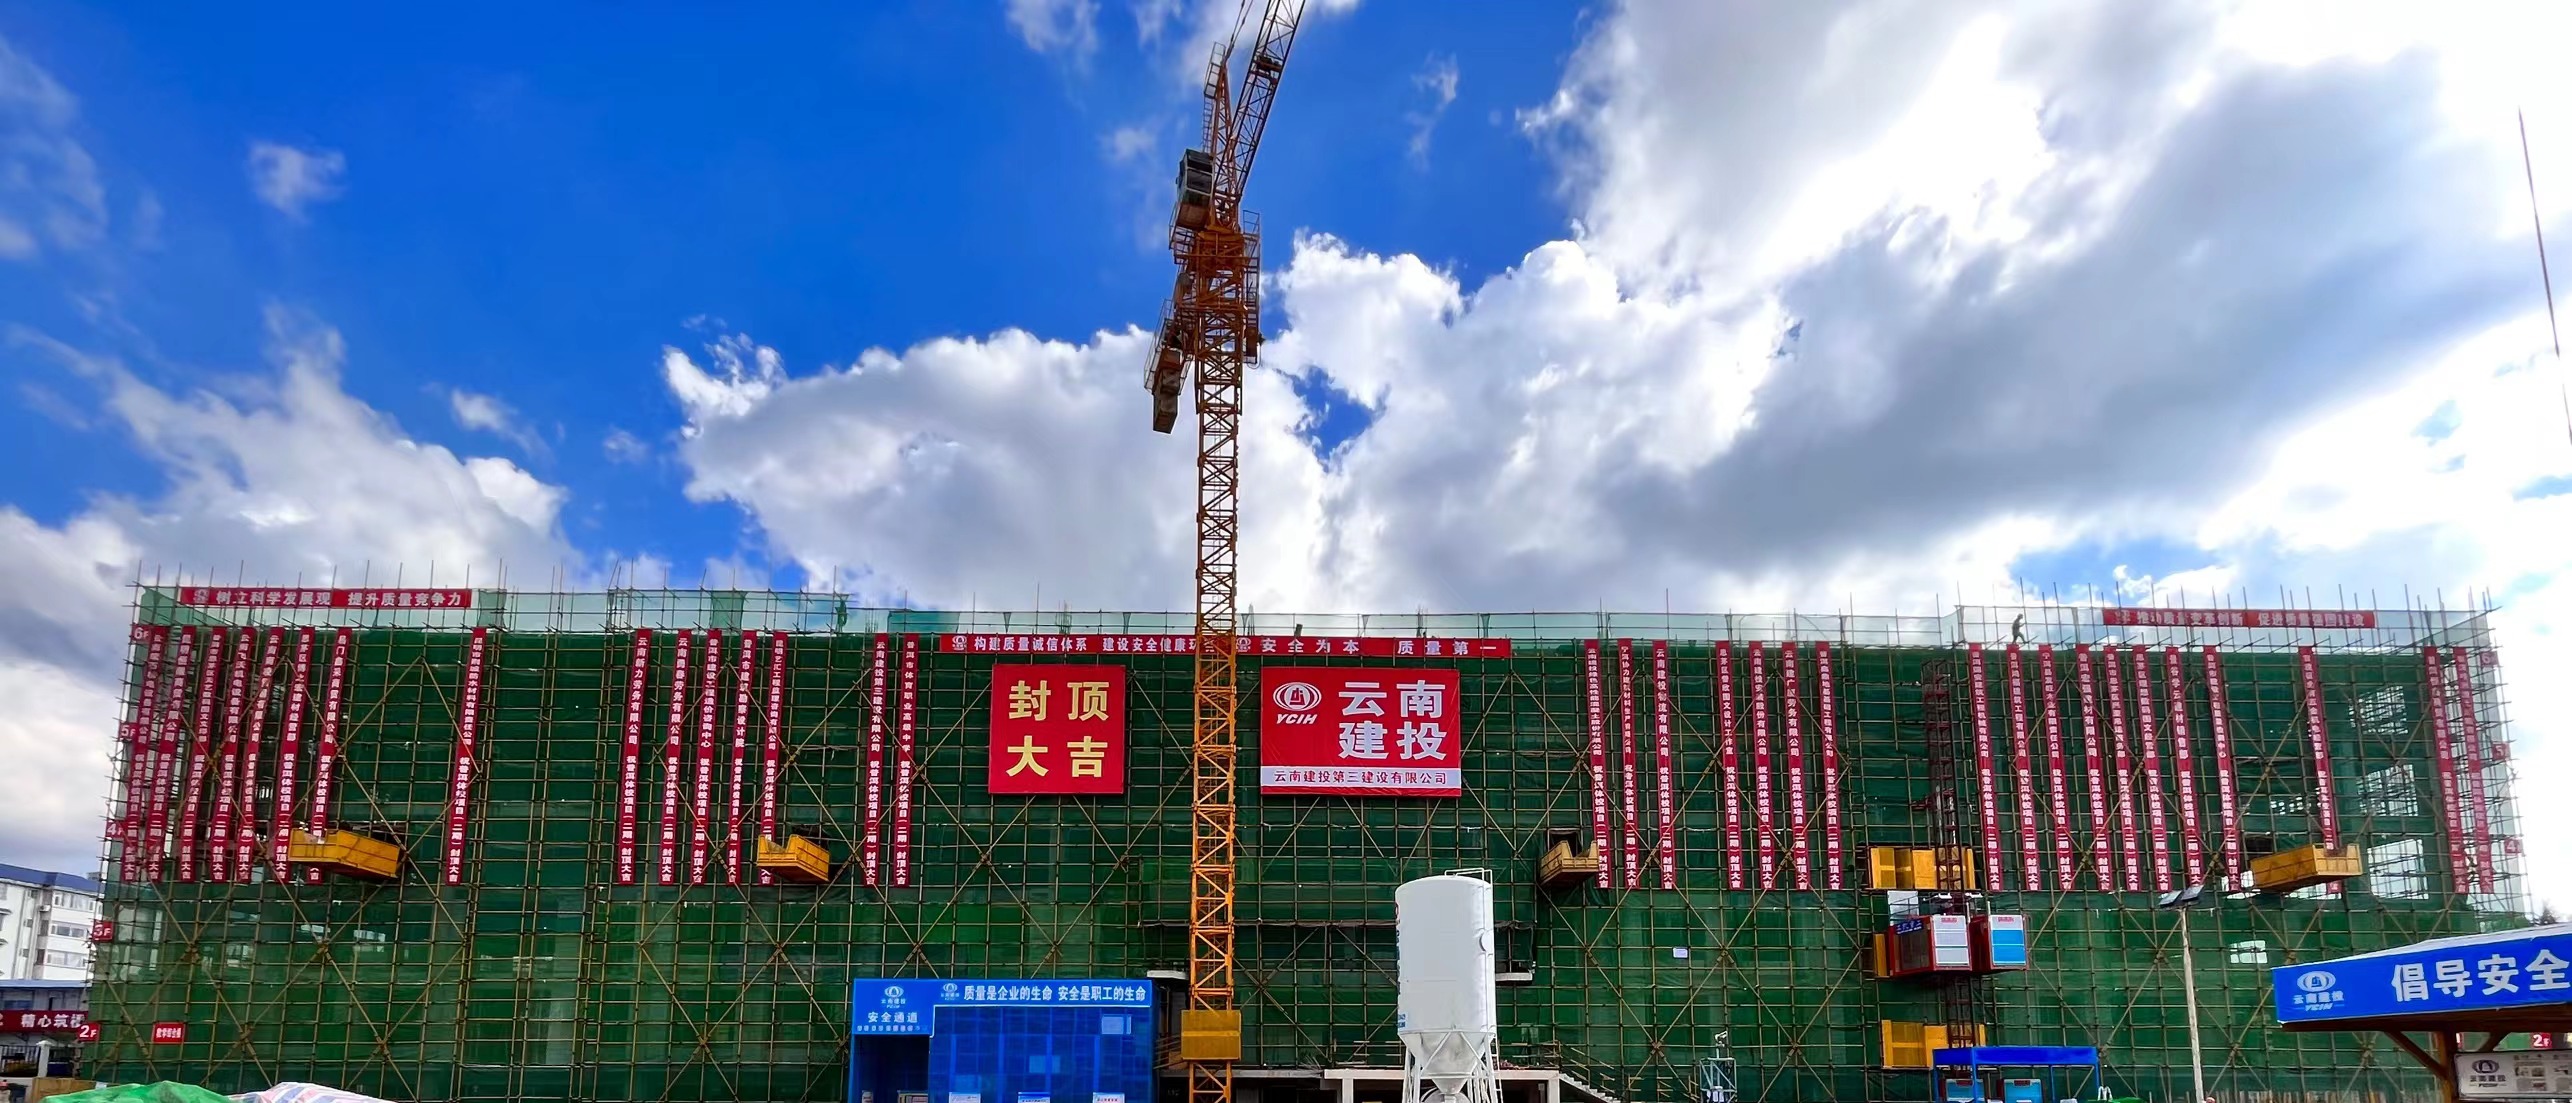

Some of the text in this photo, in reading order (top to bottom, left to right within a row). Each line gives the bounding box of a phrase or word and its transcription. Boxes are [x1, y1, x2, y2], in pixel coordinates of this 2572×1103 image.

[217, 591, 462, 606] 树立科学发展观 提升质量竞争力
[134, 627, 149, 639] 6F
[974, 636, 1087, 652] 构建质量诚信体系
[1261, 637, 1497, 656] 安全为本 质量第一
[628, 637, 649, 745] 云南新力劳务有限公司
[871, 641, 886, 752] 云南建投第三建设有限公司
[1338, 679, 1446, 719] 云南
[1008, 680, 1110, 722] 封顶
[1276, 713, 1318, 725] YCIH
[1338, 720, 1447, 761] 建投
[1007, 735, 1109, 778] 大吉
[1274, 770, 1447, 785] 云南建投第三建设有限公司
[2391, 949, 2572, 1002] 倡导安全
[964, 985, 1146, 1001] 质量是企业的生命 安全是职工的生命
[868, 1011, 918, 1023] 安全通道
[79, 1025, 97, 1038] 2F
[2533, 1034, 2549, 1047] 2F
